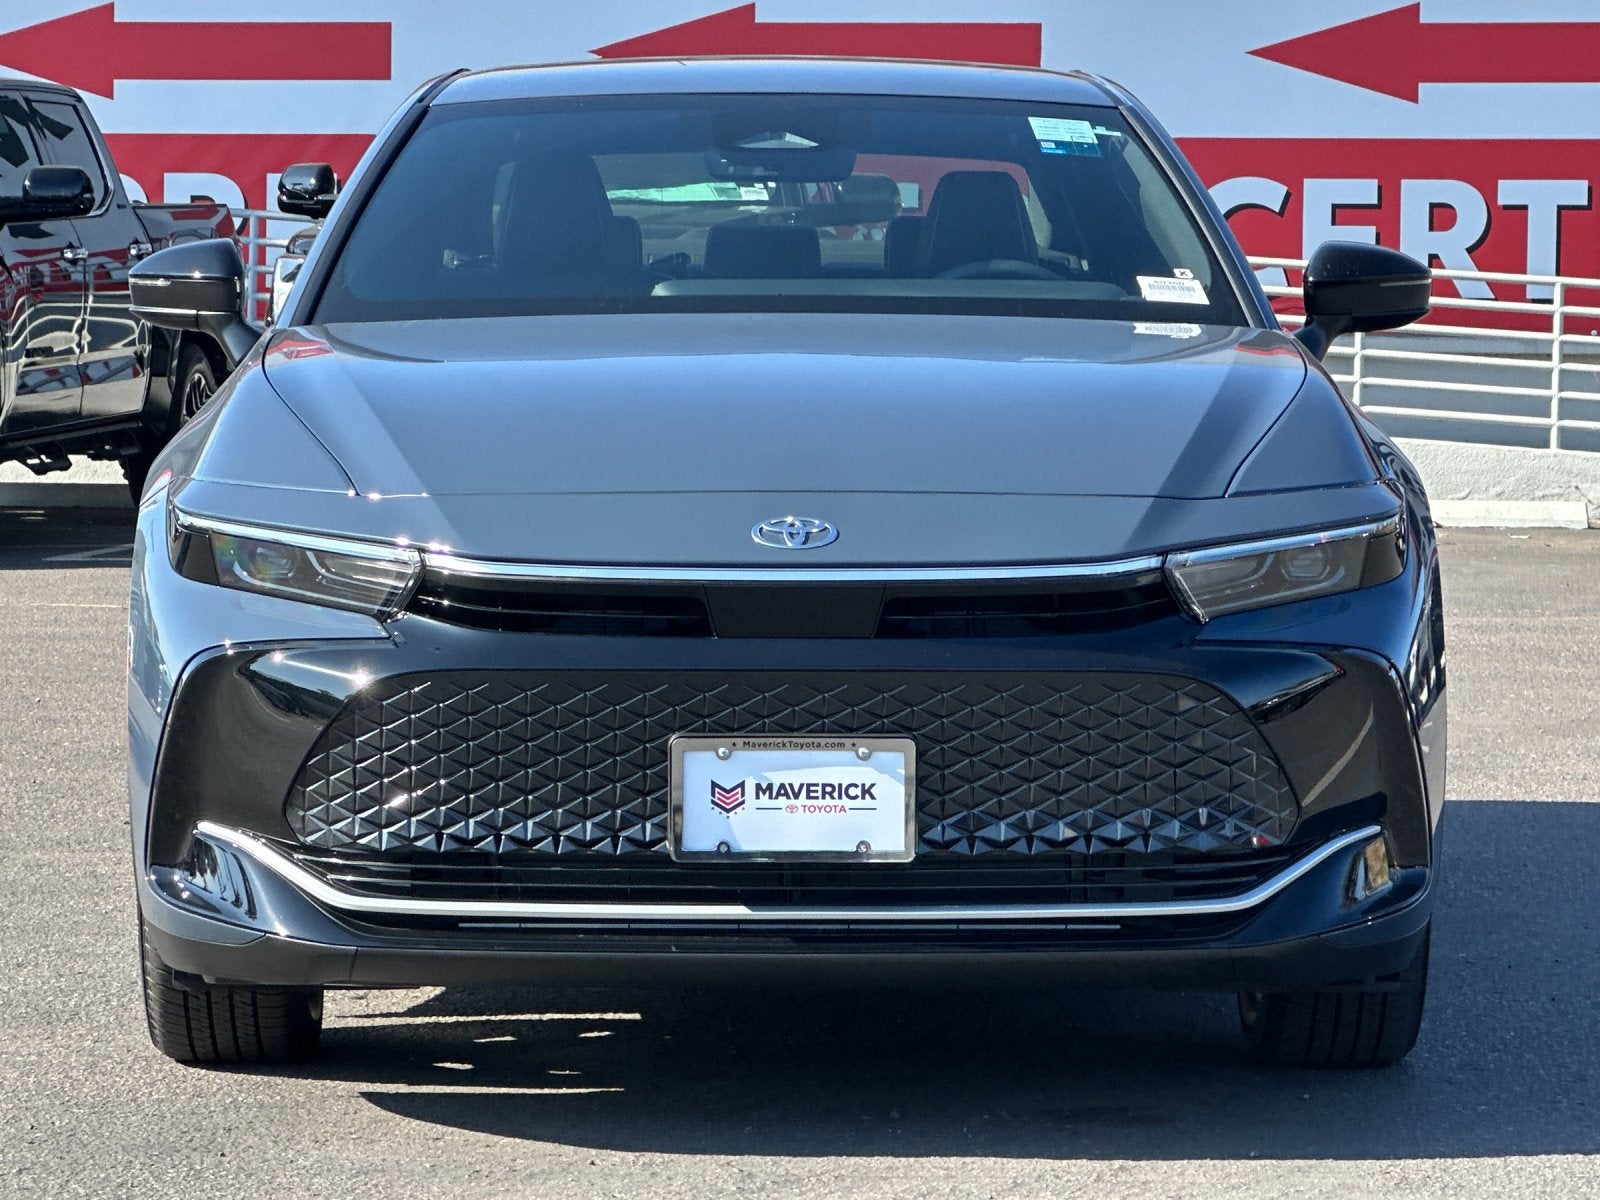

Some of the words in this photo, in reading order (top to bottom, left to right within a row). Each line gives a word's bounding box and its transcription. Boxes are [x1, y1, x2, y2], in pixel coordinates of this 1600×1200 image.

[742, 740, 846, 750] MaverickToyota.com
[755, 782, 877, 801] MAVERICK
[800, 804, 847, 814] TOYOTA
